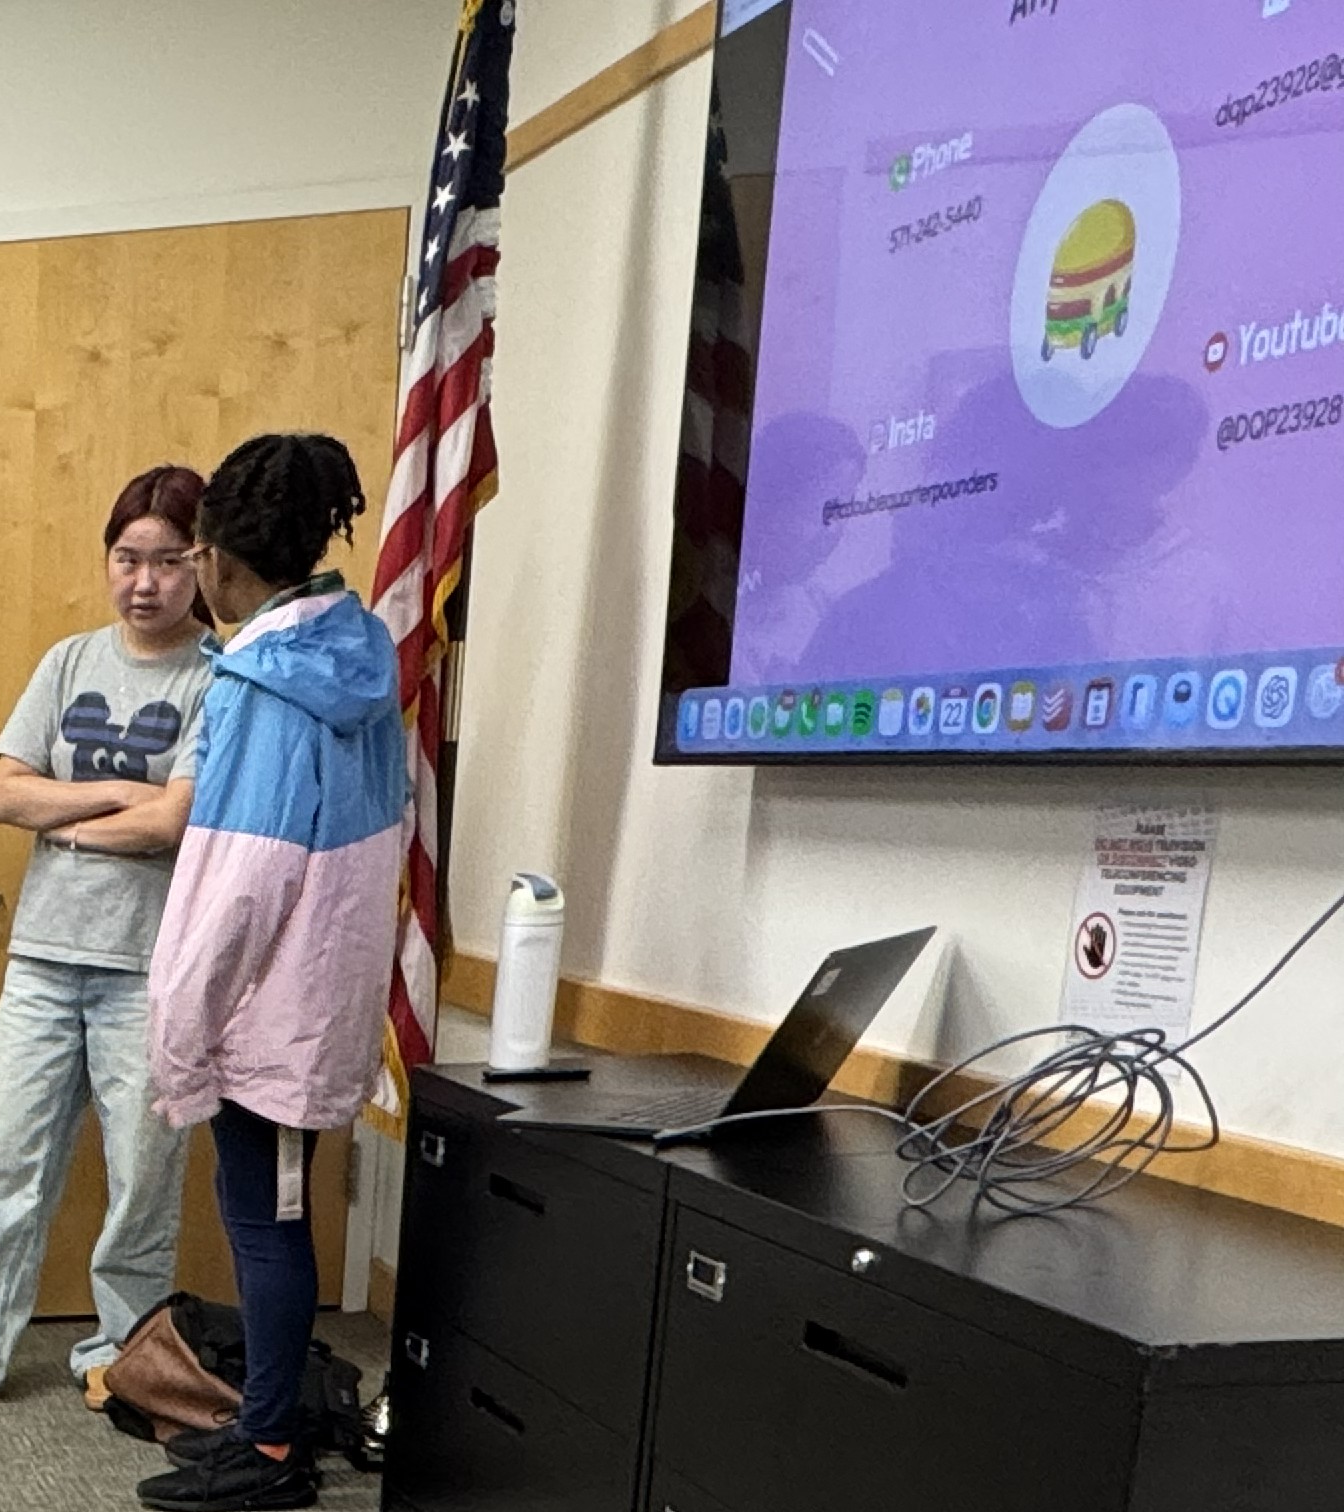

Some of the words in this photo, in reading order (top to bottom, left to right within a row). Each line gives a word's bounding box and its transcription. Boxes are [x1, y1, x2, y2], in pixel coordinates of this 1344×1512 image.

[911, 131, 973, 182] Phone
[888, 409, 935, 448] Insta
[1217, 394, 1343, 451] @DQP23928
[943, 702, 963, 728] 22
